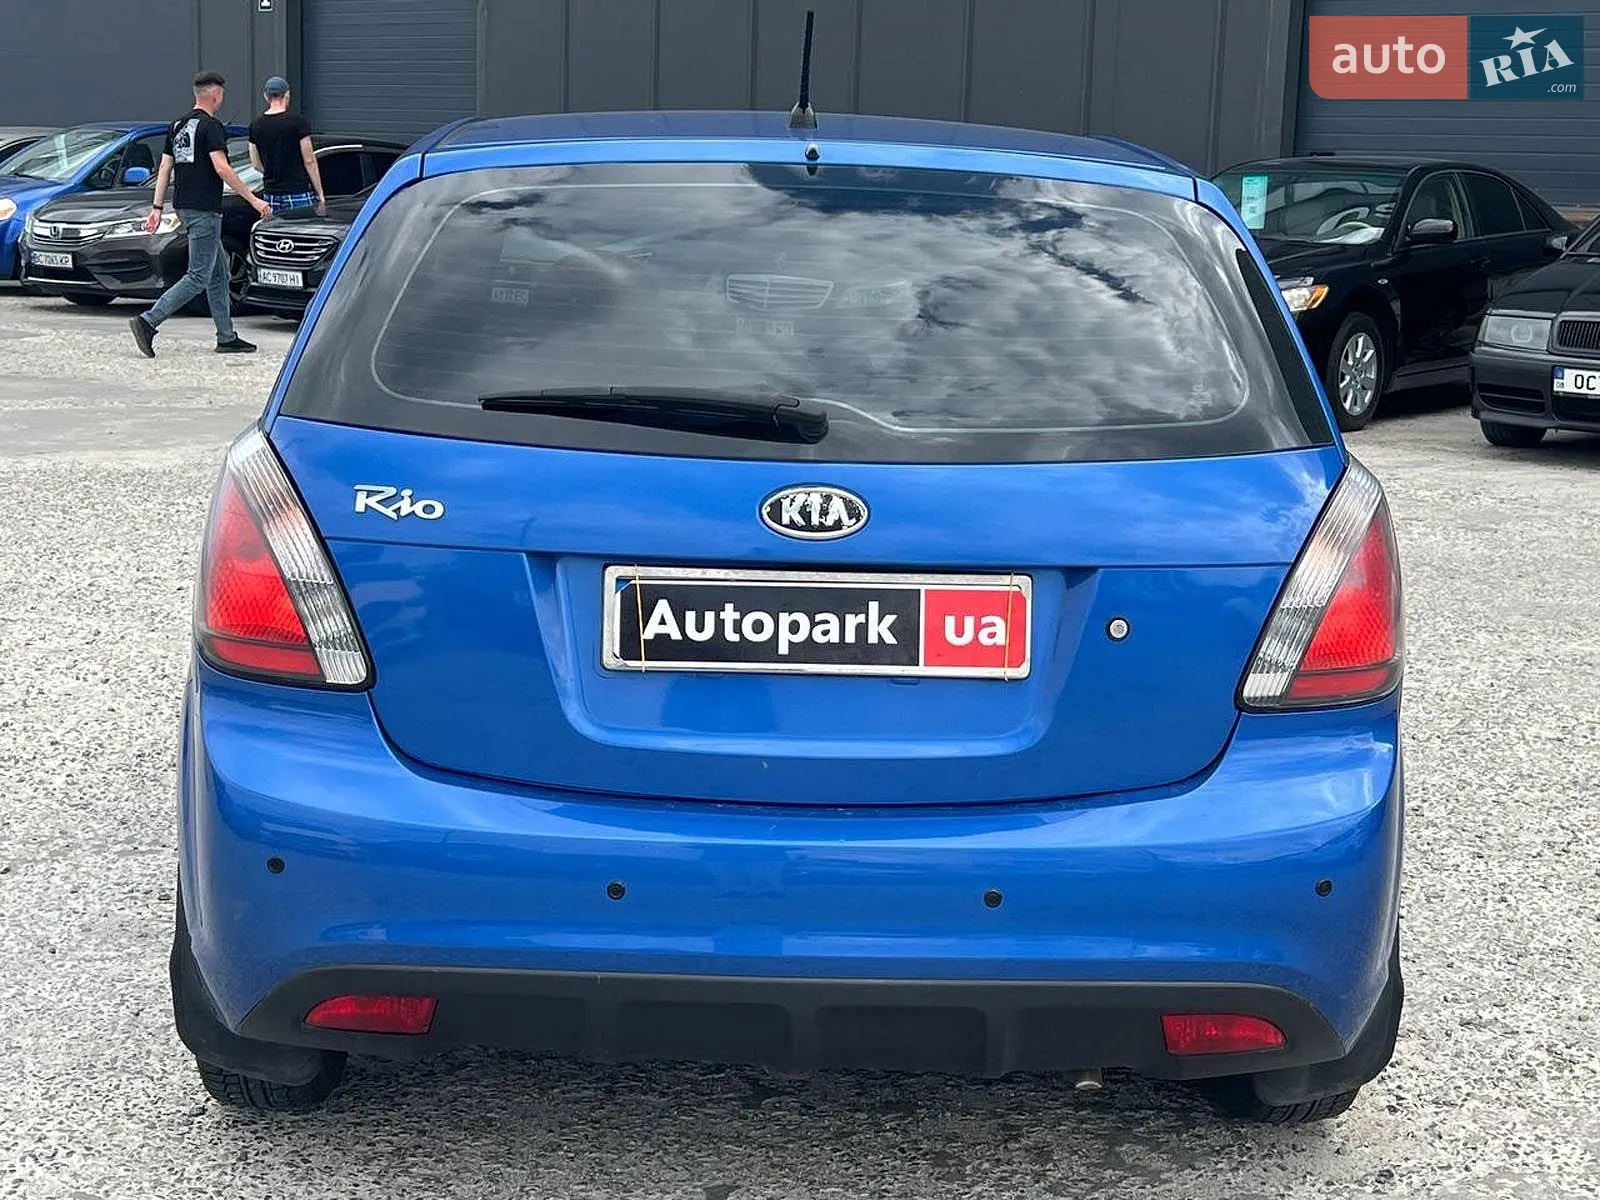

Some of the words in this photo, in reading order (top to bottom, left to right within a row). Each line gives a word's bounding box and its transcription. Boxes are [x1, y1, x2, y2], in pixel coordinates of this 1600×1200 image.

[1574, 374, 1600, 391] OC
[353, 484, 445, 520] Rio
[781, 492, 857, 526] KIA
[642, 599, 899, 655] Autopark
[943, 614, 1007, 647] ua
